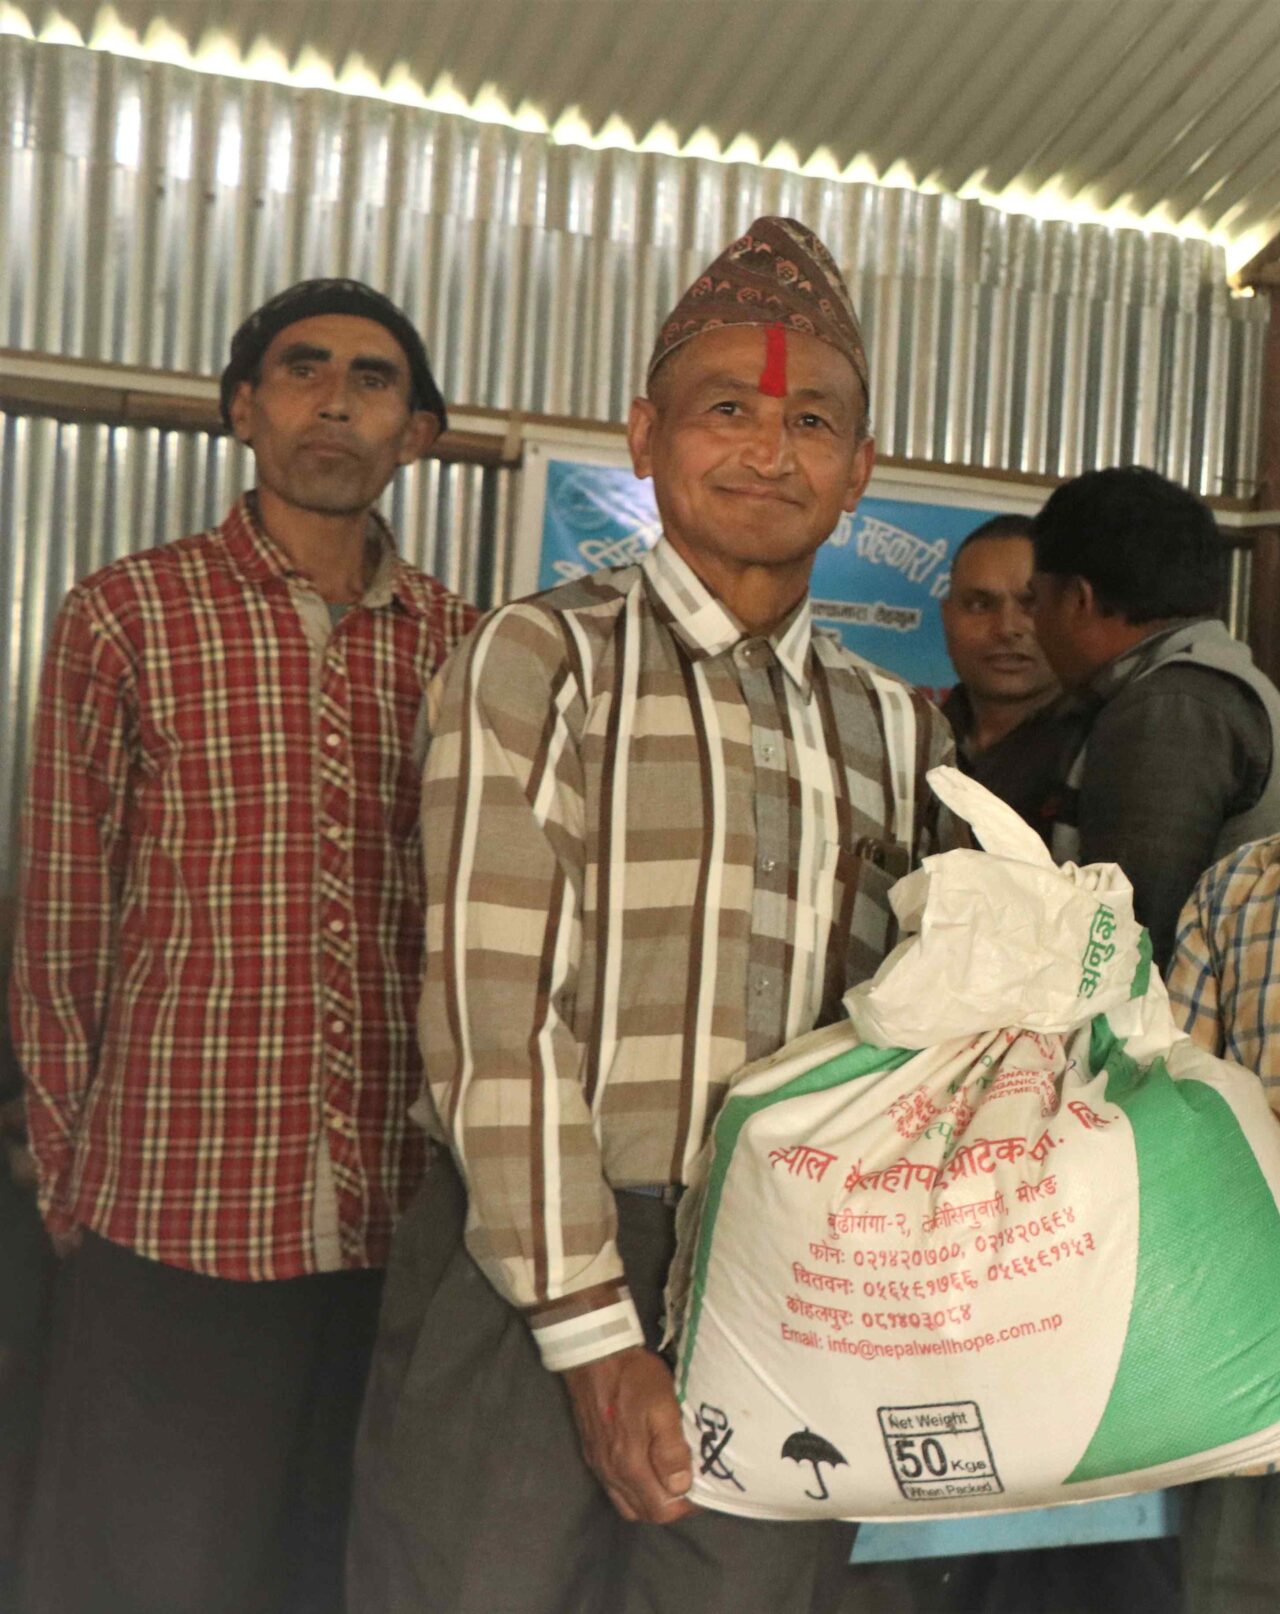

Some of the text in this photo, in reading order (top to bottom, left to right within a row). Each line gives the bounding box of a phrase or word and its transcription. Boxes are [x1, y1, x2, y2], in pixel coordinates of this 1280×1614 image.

[856, 516, 948, 583] सहकारी
[780, 1312, 1063, 1361] Email: info@nepalwellhope.com.np
[888, 1411, 968, 1431] Net Weight
[895, 1437, 987, 1478] 50 Kgs
[944, 1482, 993, 1495] Packed
